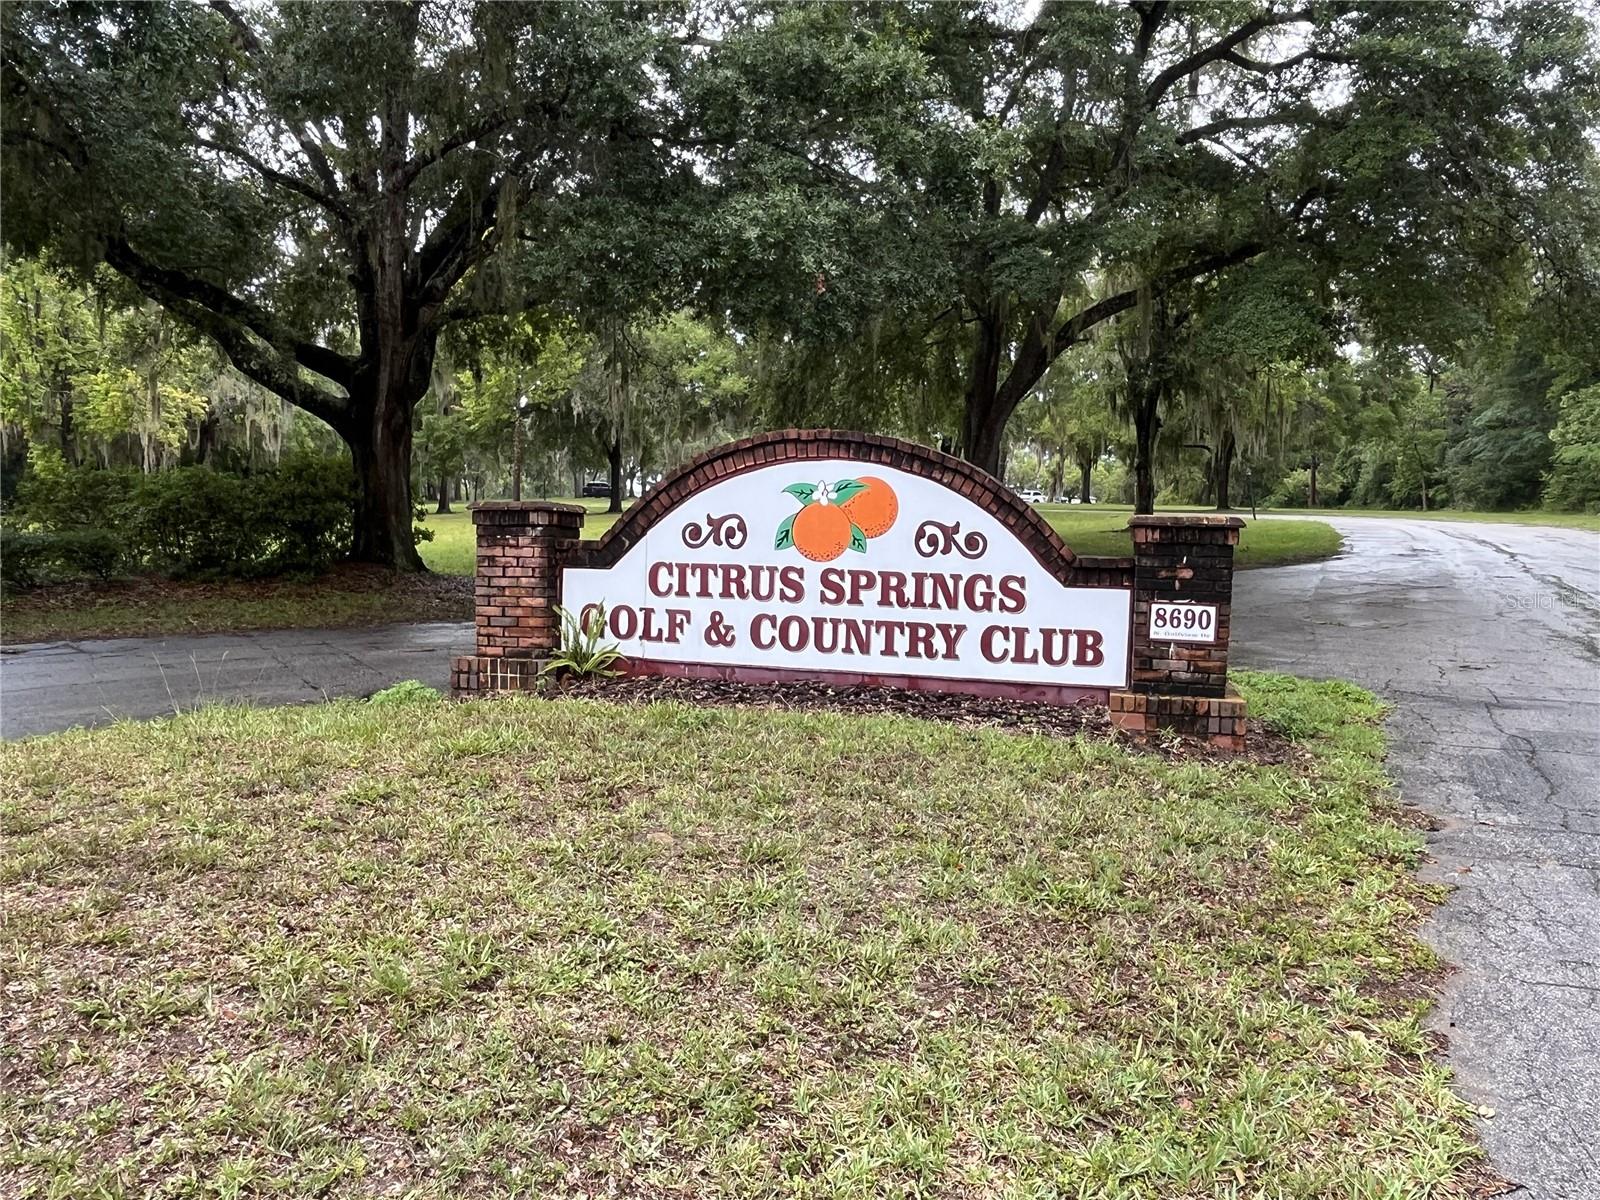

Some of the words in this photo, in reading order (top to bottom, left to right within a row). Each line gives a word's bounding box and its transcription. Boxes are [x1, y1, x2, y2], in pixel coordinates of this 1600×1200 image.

[649, 562, 804, 602] CITRUS
[820, 567, 1026, 613] SPRINGS
[704, 611, 736, 647] &
[750, 614, 967, 660] COUNTRY
[980, 625, 1105, 667] CLUB
[1154, 608, 1211, 630] 8690
